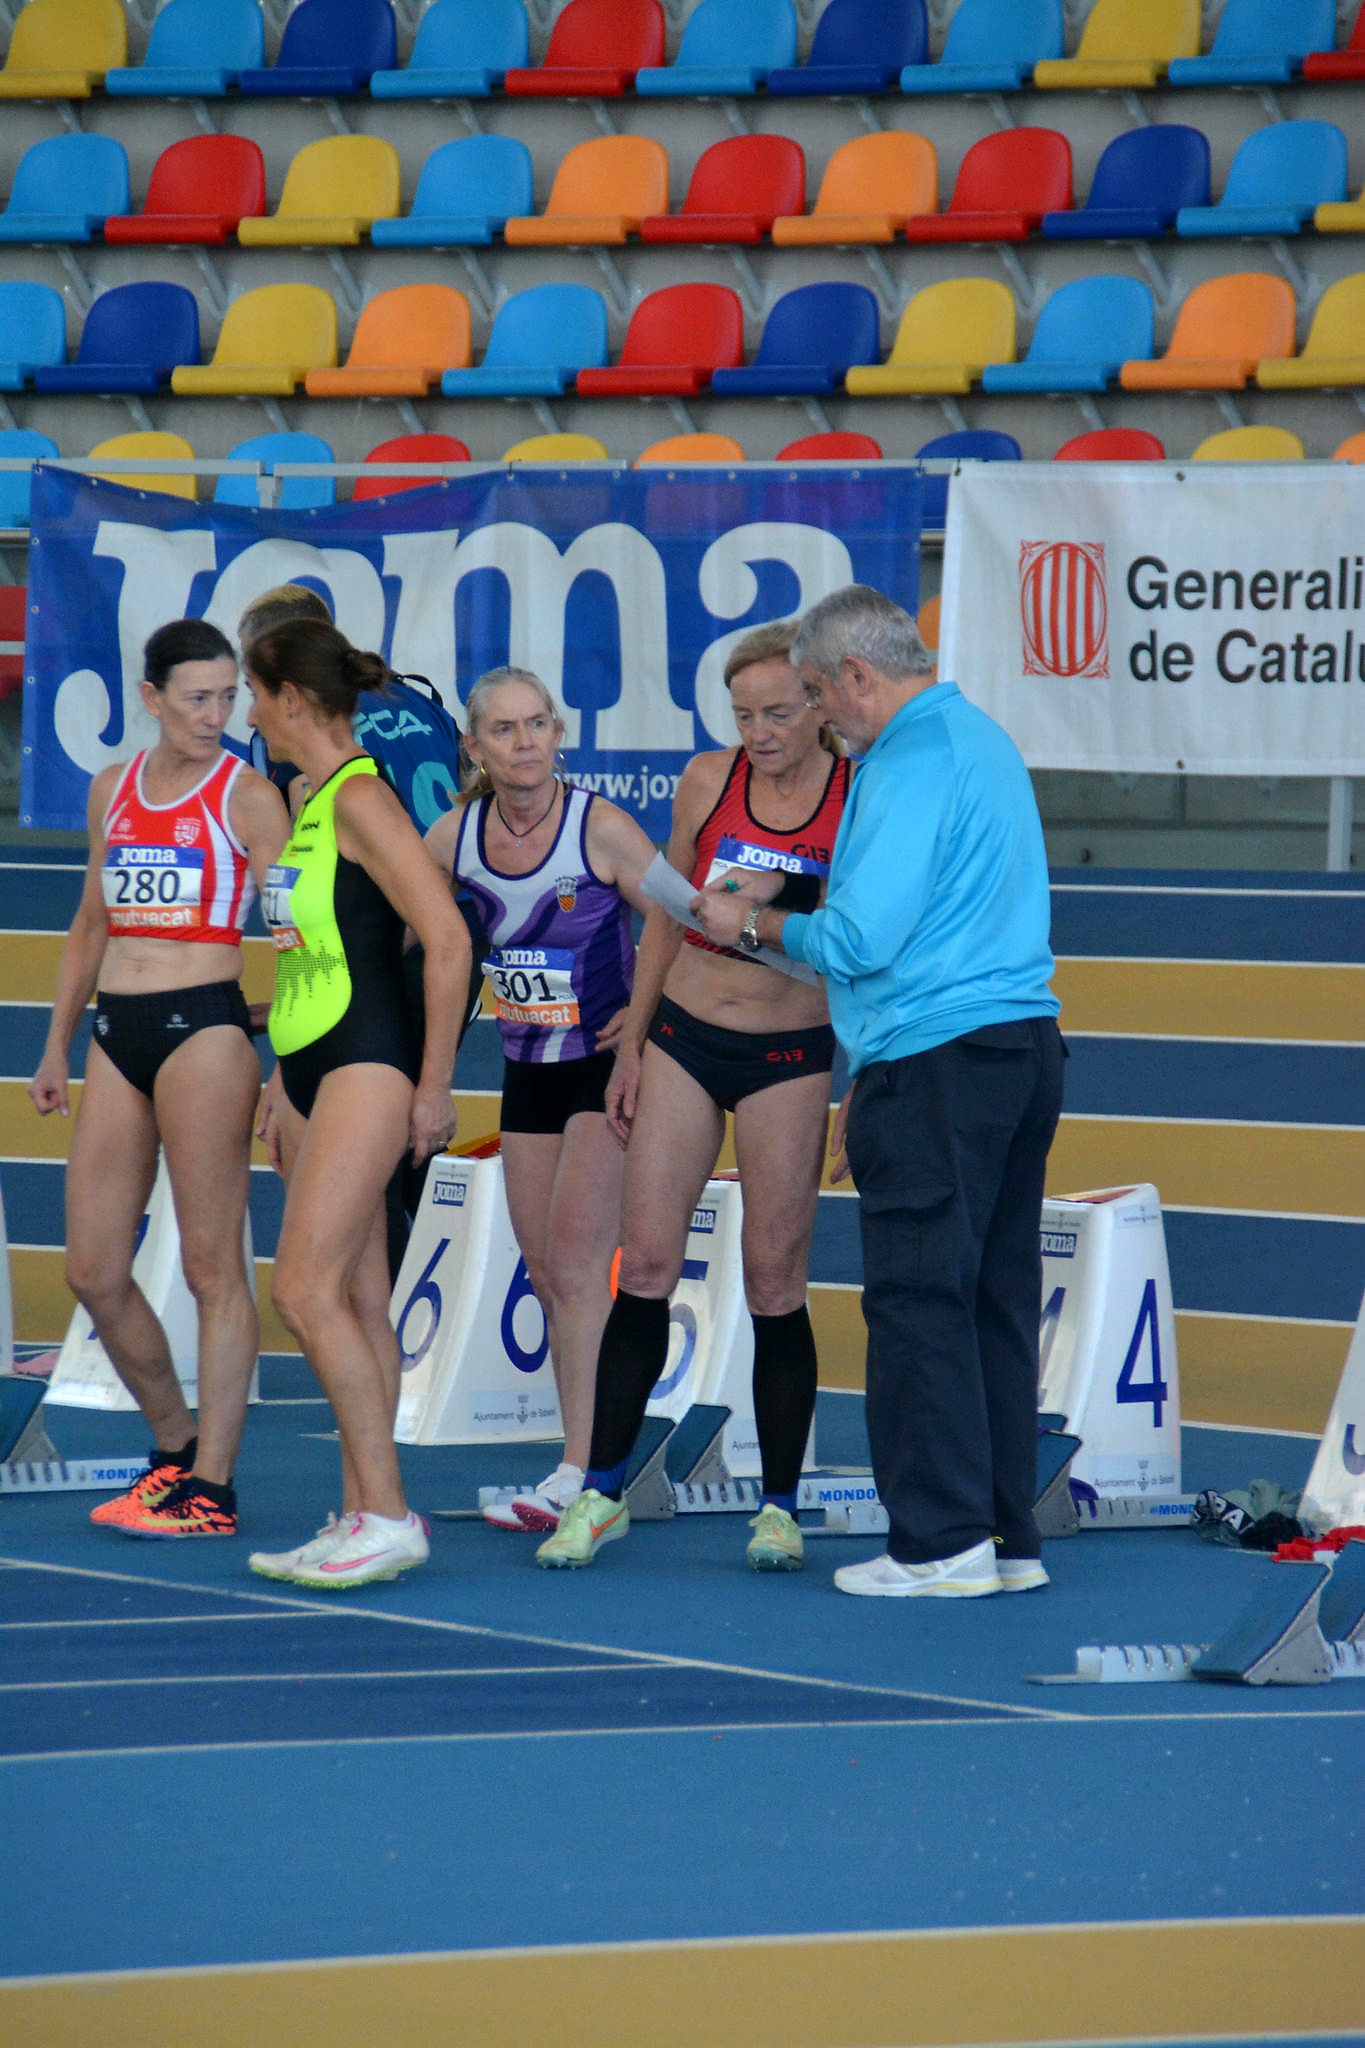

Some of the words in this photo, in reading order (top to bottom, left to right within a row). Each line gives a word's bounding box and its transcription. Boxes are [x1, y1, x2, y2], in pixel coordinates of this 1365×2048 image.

[1127, 555, 1364, 611] Generali
[1130, 629, 1195, 683] de
[1217, 628, 1365, 684] Catal
[553, 765, 683, 810] www.jo
[115, 869, 180, 904] 280
[494, 970, 557, 1003] 301
[396, 1238, 452, 1373] 6
[501, 1254, 550, 1373] 6
[1116, 1278, 1168, 1428] 4
[819, 1487, 876, 1503] MONDO
